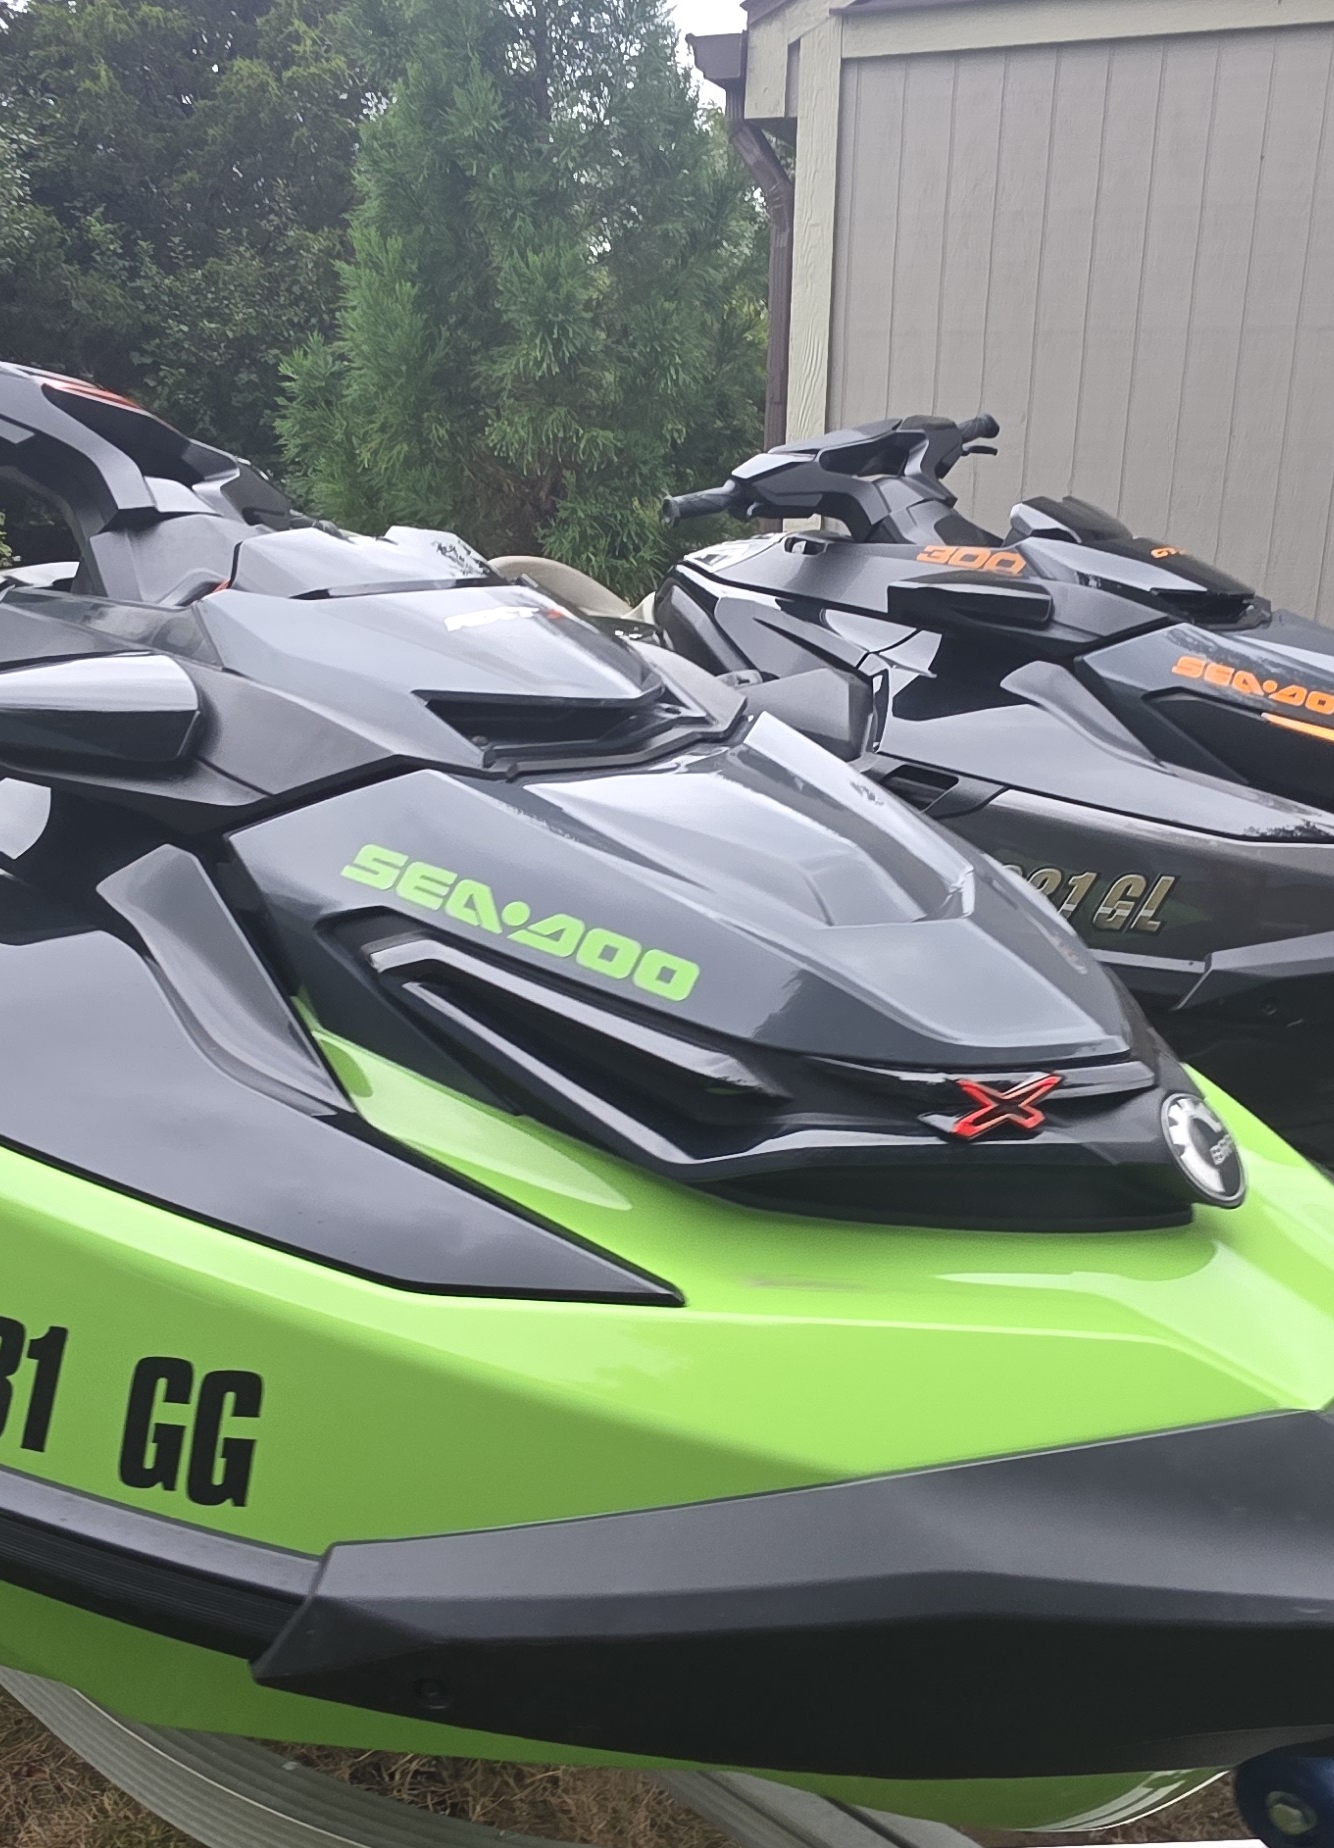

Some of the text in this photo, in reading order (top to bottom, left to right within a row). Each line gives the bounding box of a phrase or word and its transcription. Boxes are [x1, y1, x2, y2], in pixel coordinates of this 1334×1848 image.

[916, 544, 1027, 576] 300
[1092, 874, 1176, 932] GL
[118, 1356, 263, 1508] GG
